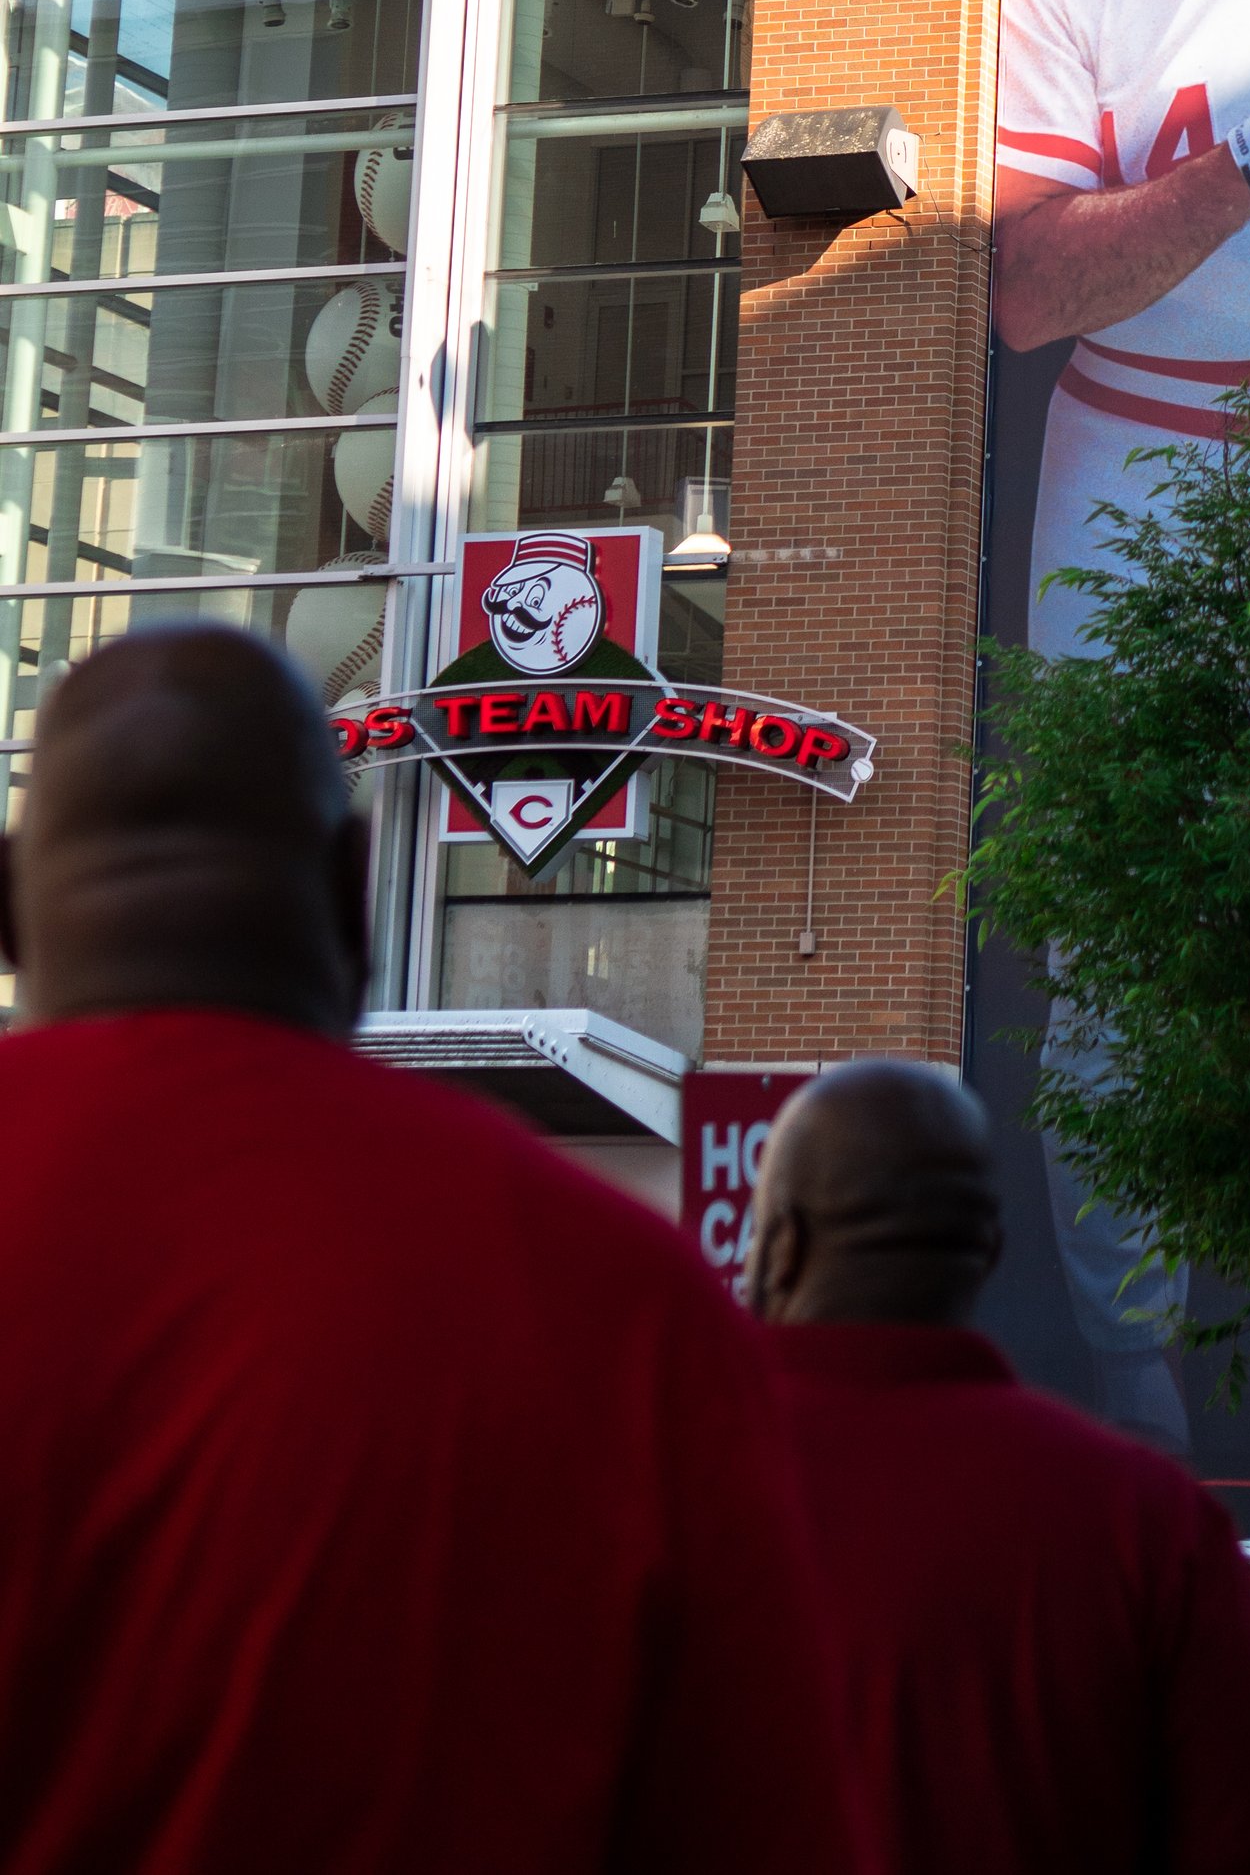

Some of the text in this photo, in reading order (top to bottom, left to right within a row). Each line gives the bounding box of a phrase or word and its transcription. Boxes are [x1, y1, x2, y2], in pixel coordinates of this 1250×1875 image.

[1101, 83, 1215, 187] 14
[328, 691, 852, 768] DS TEAM SHOP
[508, 794, 553, 830] C
[701, 1121, 772, 1192] HO
